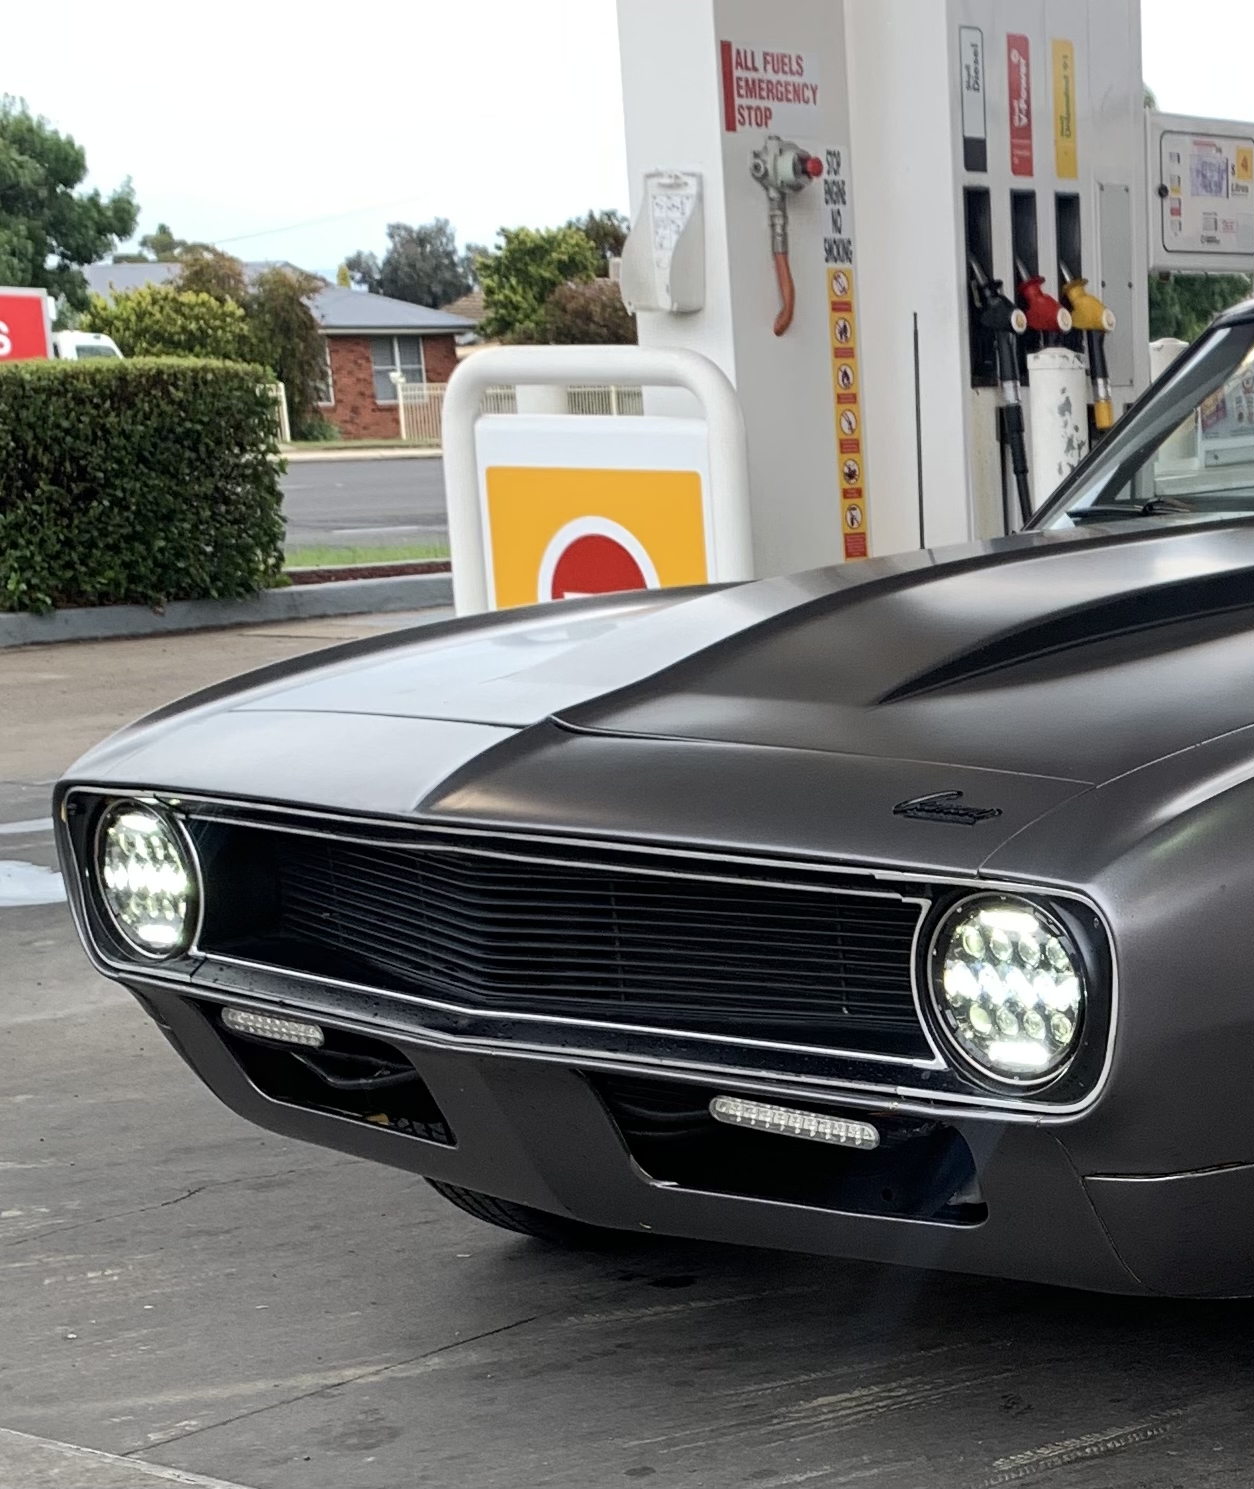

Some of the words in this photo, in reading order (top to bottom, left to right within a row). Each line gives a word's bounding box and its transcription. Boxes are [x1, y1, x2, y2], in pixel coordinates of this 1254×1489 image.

[735, 48, 759, 72] ALL
[763, 52, 804, 77] FUELS
[970, 43, 980, 92] Diesel
[735, 77, 818, 106] EMERGENCY
[737, 104, 773, 128] STOP
[826, 148, 841, 176] STOP
[824, 179, 847, 205] ENGINE
[831, 209, 842, 234] NO
[824, 237, 852, 265] SMOKING
